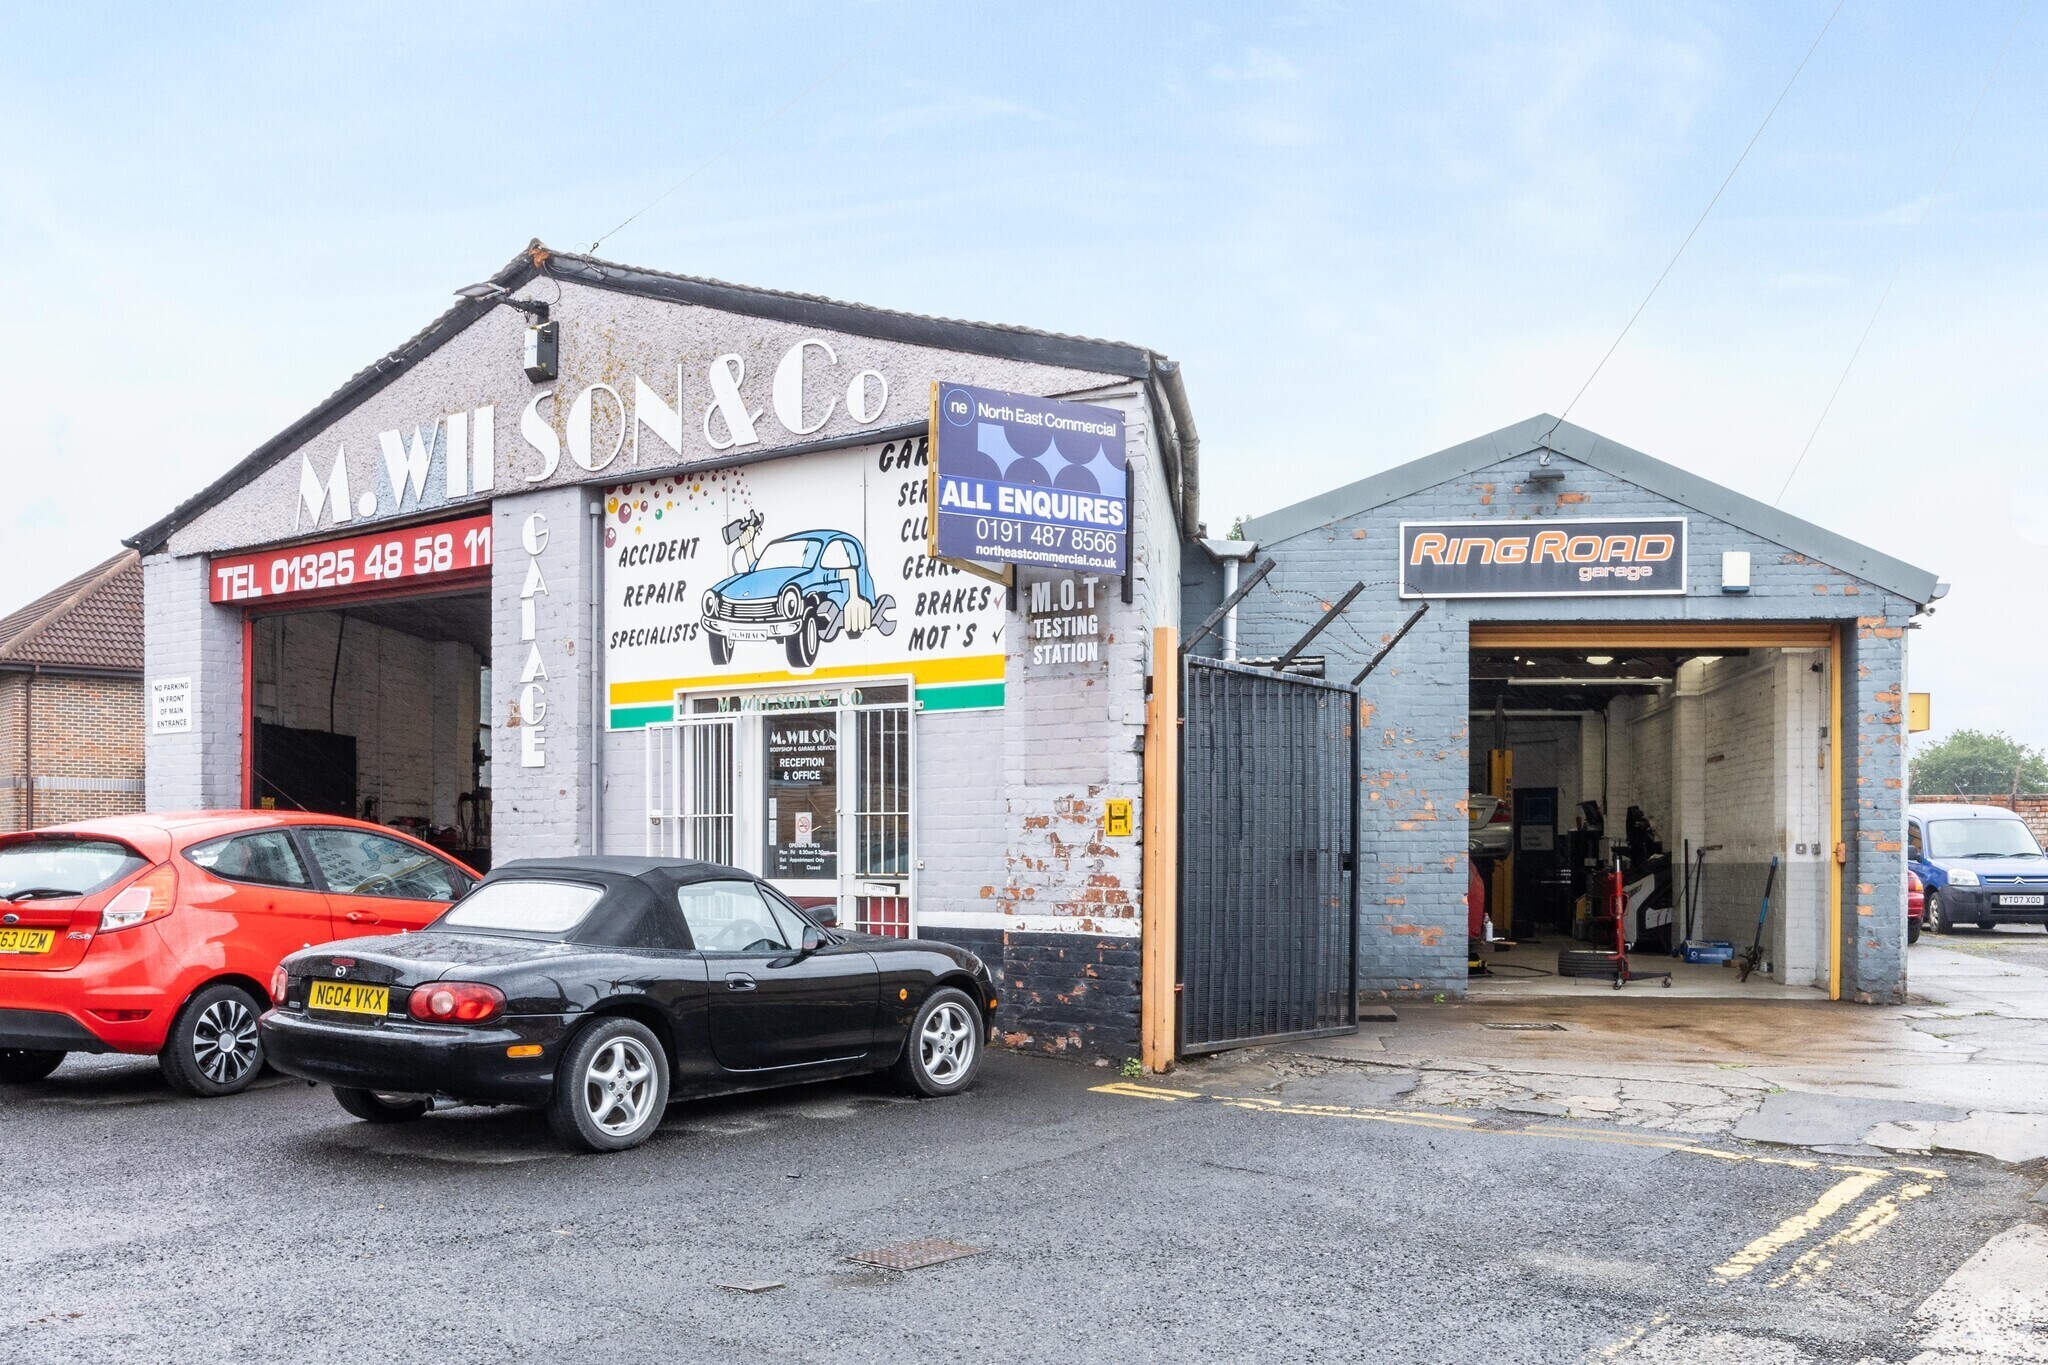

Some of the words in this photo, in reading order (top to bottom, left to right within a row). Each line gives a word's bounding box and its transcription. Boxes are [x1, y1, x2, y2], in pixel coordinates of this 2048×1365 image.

[950, 400, 968, 414] ne
[978, 402, 1014, 422] North
[1016, 408, 1042, 425] East
[1044, 413, 1116, 437] Commercial
[941, 480, 992, 511] ALL
[998, 486, 1124, 526] ENQUIRES
[976, 518, 1022, 543] 0191
[1030, 524, 1066, 547] 487
[1071, 529, 1117, 554] 8566
[217, 564, 262, 601] TEL
[271, 549, 354, 595] 01325
[364, 541, 403, 580] 48
[414, 533, 453, 574] 58
[464, 526, 491, 567] 11
[618, 537, 701, 568] ACCIDENT
[976, 544, 1117, 569] northeastcommercial.co.uk
[1579, 565, 1653, 582] garage
[623, 580, 687, 608] REPAIR
[914, 585, 992, 617] BRAKES
[1031, 577, 1099, 614] M.O.T
[610, 622, 700, 650] SPECIALISTS
[908, 622, 978, 651] MOT'S
[1034, 615, 1098, 639] TESTING
[1033, 641, 1098, 666] STATION
[154, 684, 162, 692] NO
[164, 682, 189, 690] PARKING
[166, 694, 185, 703] FRONT
[740, 692, 810, 711] WILSON
[818, 689, 832, 708] &
[839, 688, 863, 707] CO
[157, 718, 187, 728] ENTRANCE
[160, 708, 167, 716] OF
[169, 707, 184, 715] MAIN
[779, 757, 825, 768] RECEPTION
[783, 771, 790, 780] &
[792, 770, 821, 780] OFFICE
[20, 932, 48, 949] UZM
[316, 984, 352, 1007] NG04
[355, 988, 385, 1010] VKX
